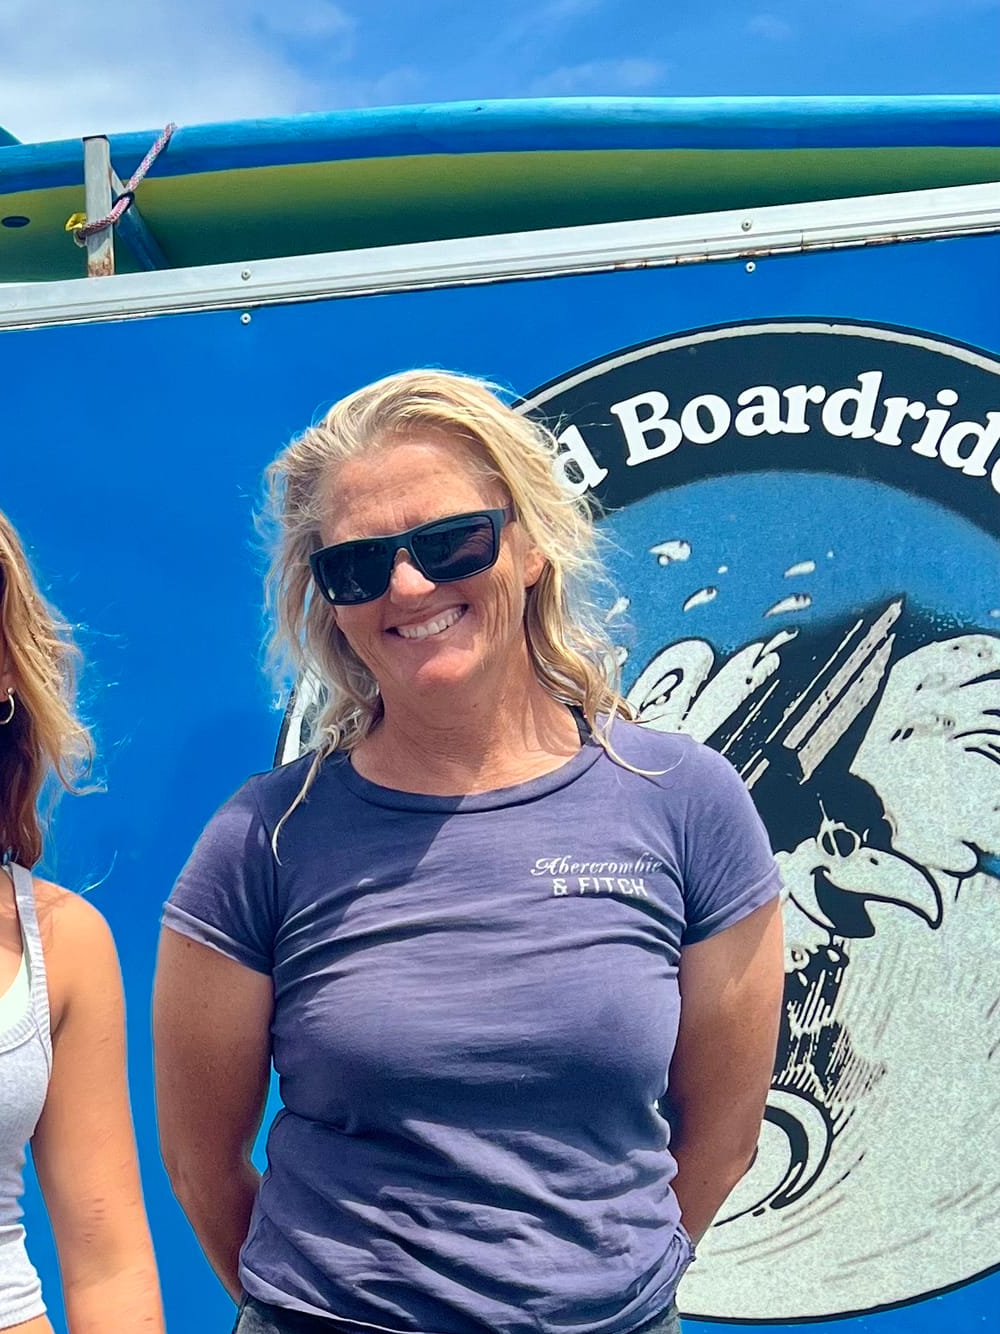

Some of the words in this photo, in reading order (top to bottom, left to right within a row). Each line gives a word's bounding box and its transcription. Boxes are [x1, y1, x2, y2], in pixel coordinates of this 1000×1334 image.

[552, 424, 609, 496] d
[610, 371, 1000, 494] Boardrid
[530, 852, 663, 876] Abercrombie
[553, 878, 568, 896] &
[577, 877, 649, 897] FITCH
